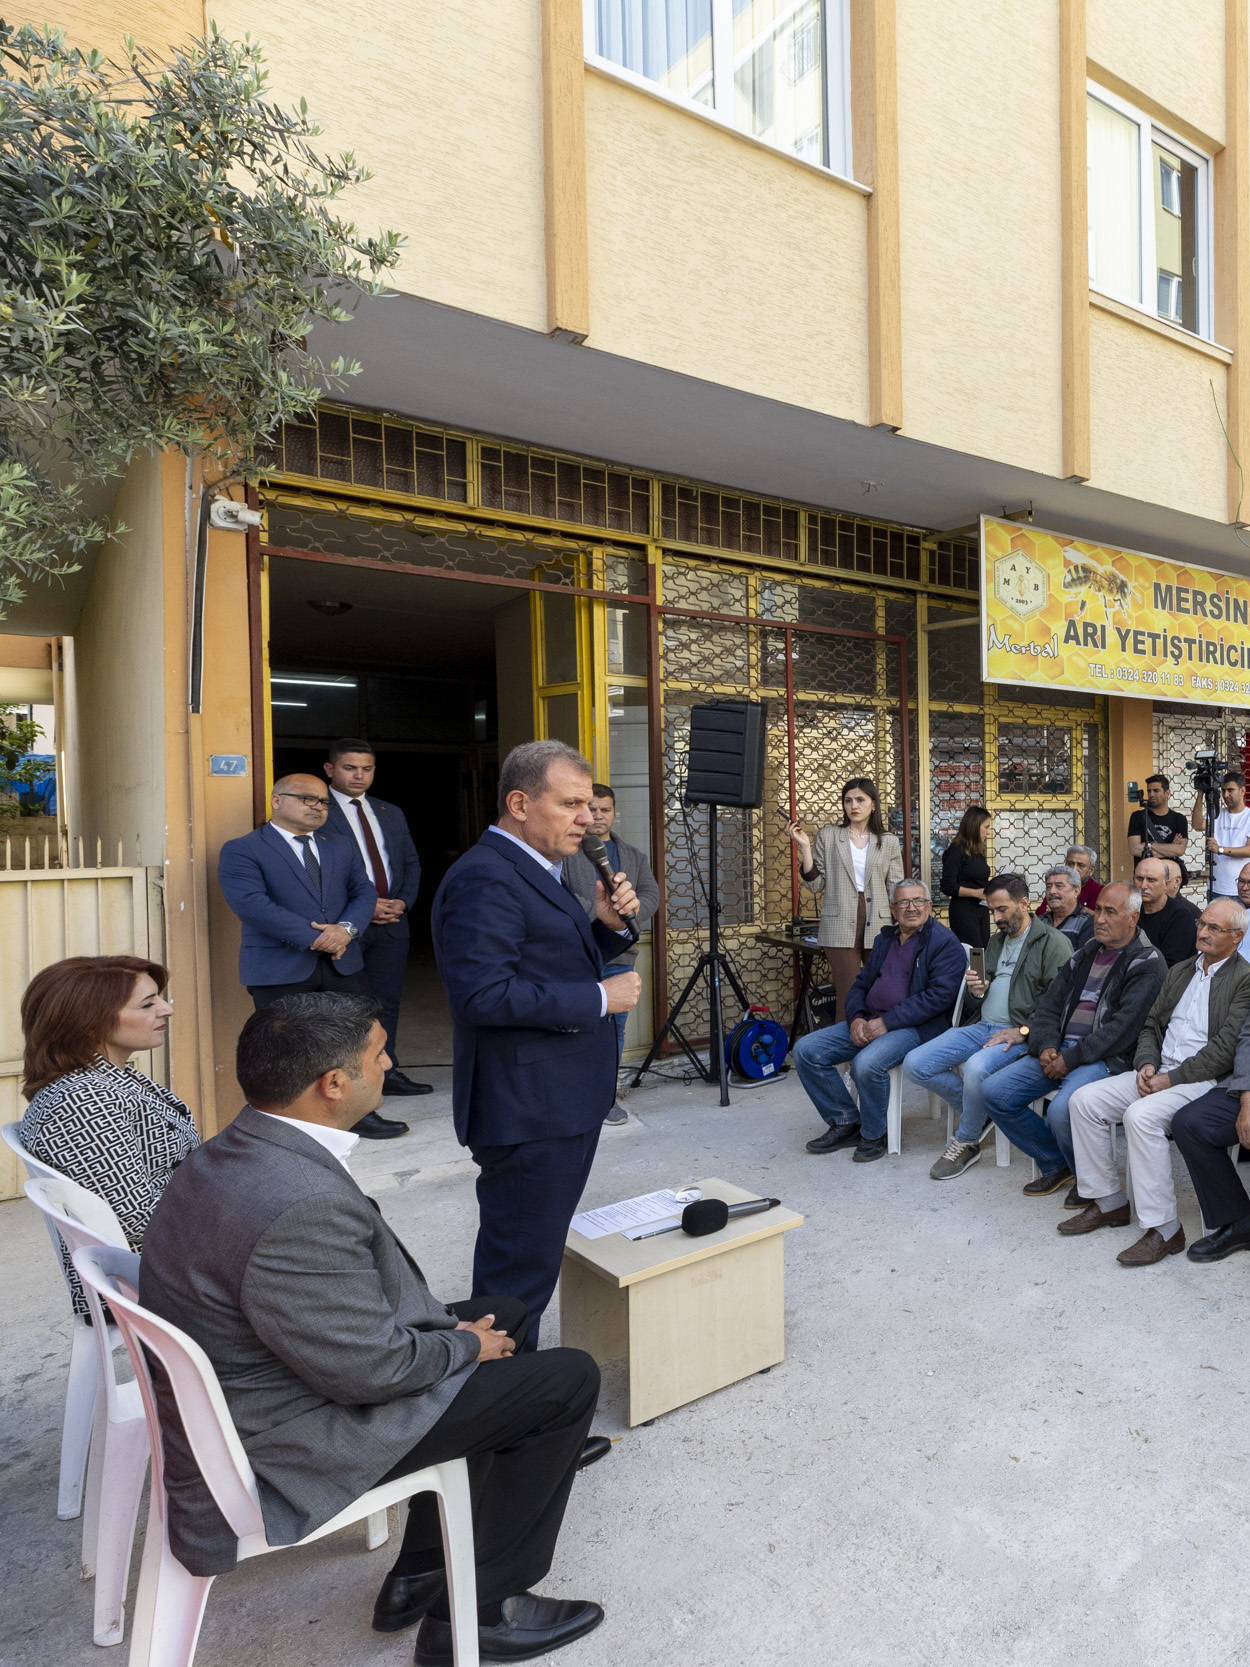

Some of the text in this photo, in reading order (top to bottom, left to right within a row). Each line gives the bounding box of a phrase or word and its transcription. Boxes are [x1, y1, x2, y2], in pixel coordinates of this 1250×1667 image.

[1153, 581, 1248, 626] MERSİN
[988, 623, 1059, 659] Merbal
[1063, 618, 1107, 650] ARI
[1088, 663, 1108, 678] TEL
[1116, 667, 1139, 682] 0324
[1142, 670, 1158, 684] 320
[1161, 672, 1171, 685] 11
[1174, 674, 1184, 687] 83
[1191, 676, 1213, 690] FAKS
[1220, 680, 1239, 692] 0324
[220, 760, 237, 771] 47
